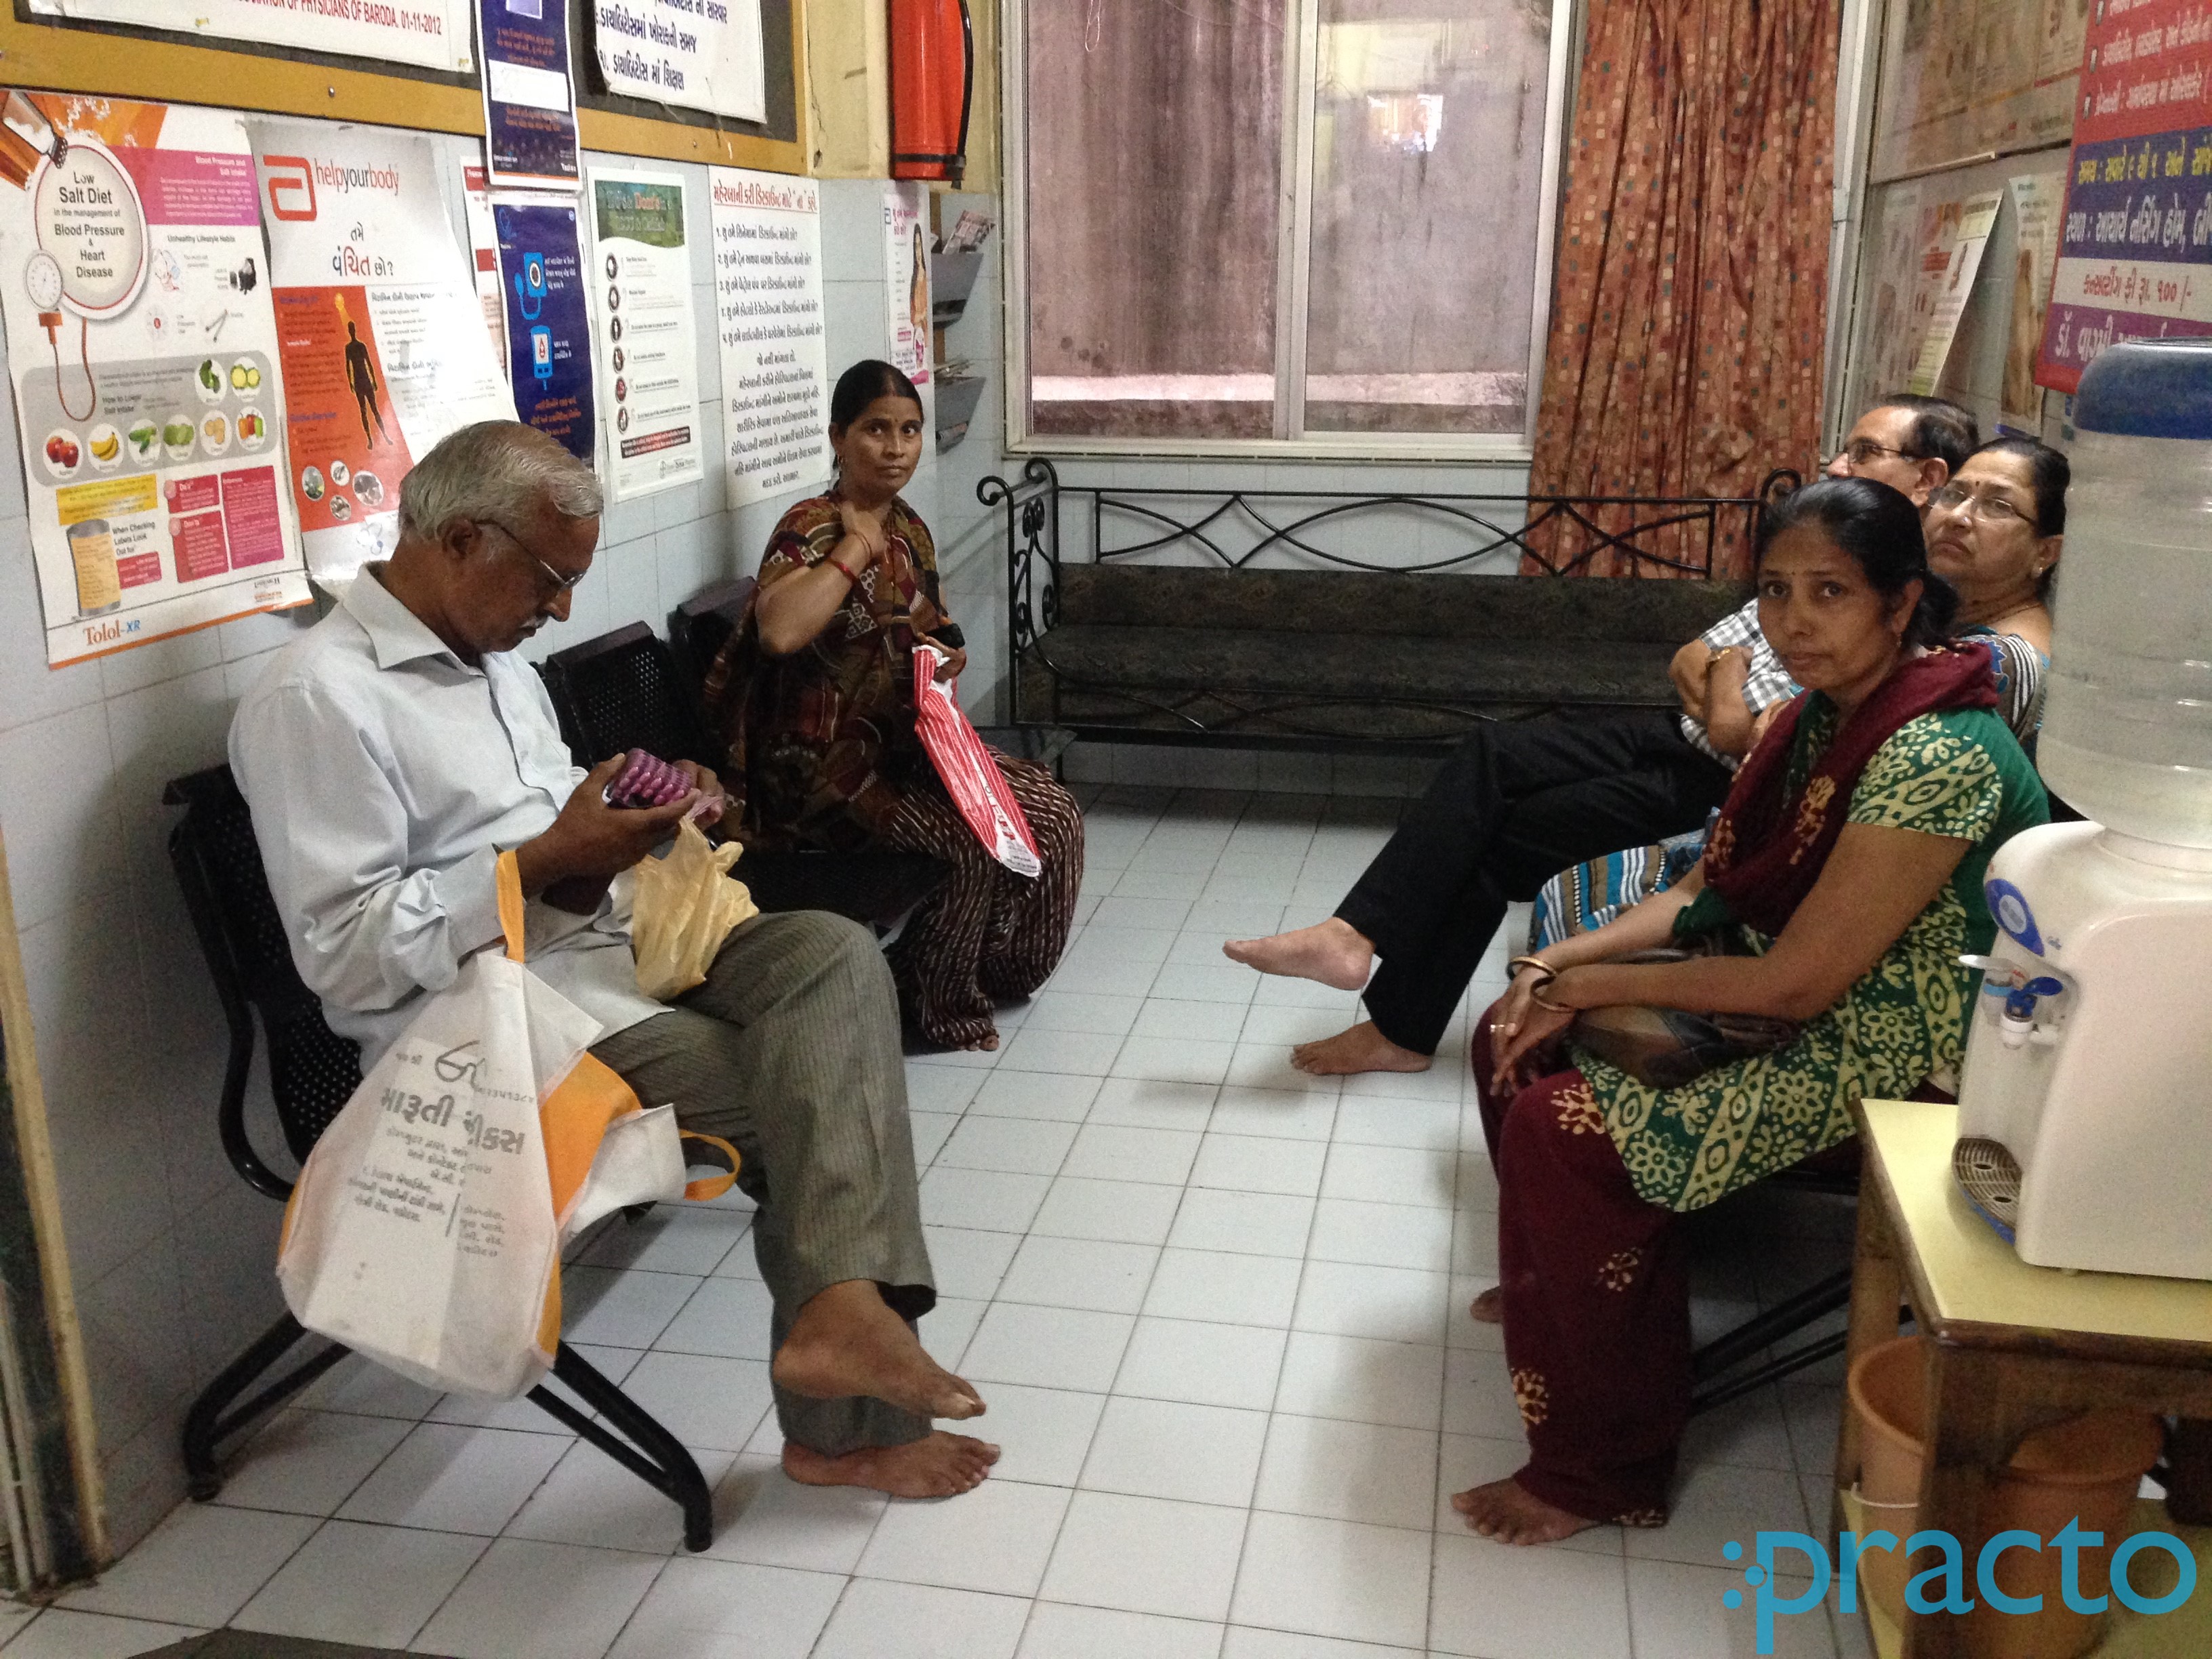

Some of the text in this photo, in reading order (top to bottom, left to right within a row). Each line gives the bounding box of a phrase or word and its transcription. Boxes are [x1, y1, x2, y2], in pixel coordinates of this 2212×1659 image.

[302, 0, 350, 20] PHYSICIANS
[351, 0, 361, 21] OF
[401, 10, 442, 36] 01-11-2012
[679, 32, 697, 54] સમજ
[663, 59, 684, 91] શિક્ષણ
[73, 171, 95, 184] Low
[314, 158, 398, 197] helpyourbody
[59, 186, 113, 205] Salt Diet
[714, 178, 743, 205] મહેરબાની
[743, 182, 754, 205] કરી
[62, 208, 72, 217] the
[73, 209, 112, 219] management
[114, 209, 121, 218] of
[54, 224, 125, 237] Blood Pressure
[350, 222, 365, 242] તમે
[80, 249, 106, 262] Heart
[332, 245, 371, 277] વંચિત
[76, 266, 113, 279] Disease
